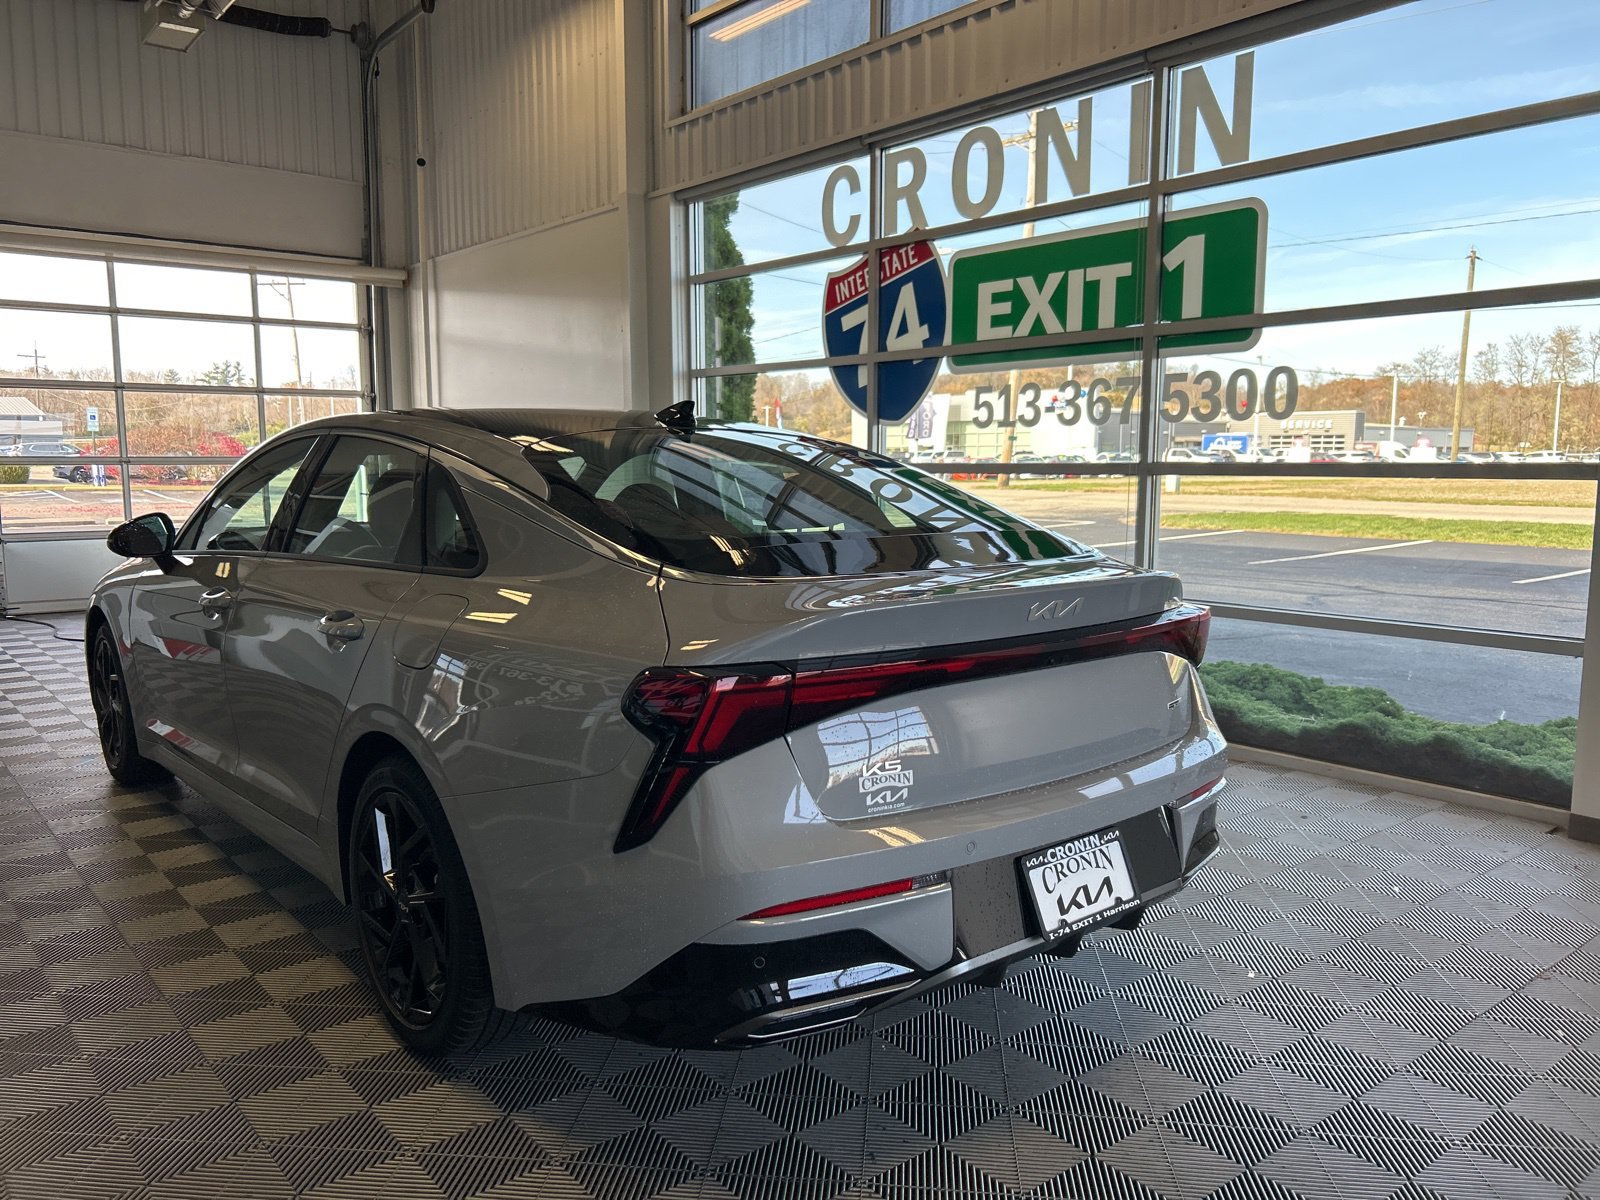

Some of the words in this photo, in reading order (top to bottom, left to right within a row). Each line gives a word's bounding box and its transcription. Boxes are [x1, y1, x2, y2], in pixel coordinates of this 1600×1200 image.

[821, 50, 1255, 247] CRONIN
[835, 244, 918, 303] INTETATE
[977, 262, 1132, 341] EXIT
[1163, 234, 1206, 320] 1
[972, 366, 1299, 429] 513-3675300
[1280, 419, 1333, 430] SERVICE
[1026, 597, 1084, 621] KIA
[862, 771, 911, 791] CRONIN
[863, 760, 901, 777] K5
[866, 787, 909, 806] KIA
[867, 802, 906, 813] croninkia.com
[1046, 834, 1100, 863] CRONIN
[1042, 846, 1114, 894] CRONIN
[1056, 875, 1114, 917] KIA
[1048, 926, 1071, 940] I-74
[1072, 917, 1094, 930] EXIT
[1103, 899, 1141, 918] Harrison
